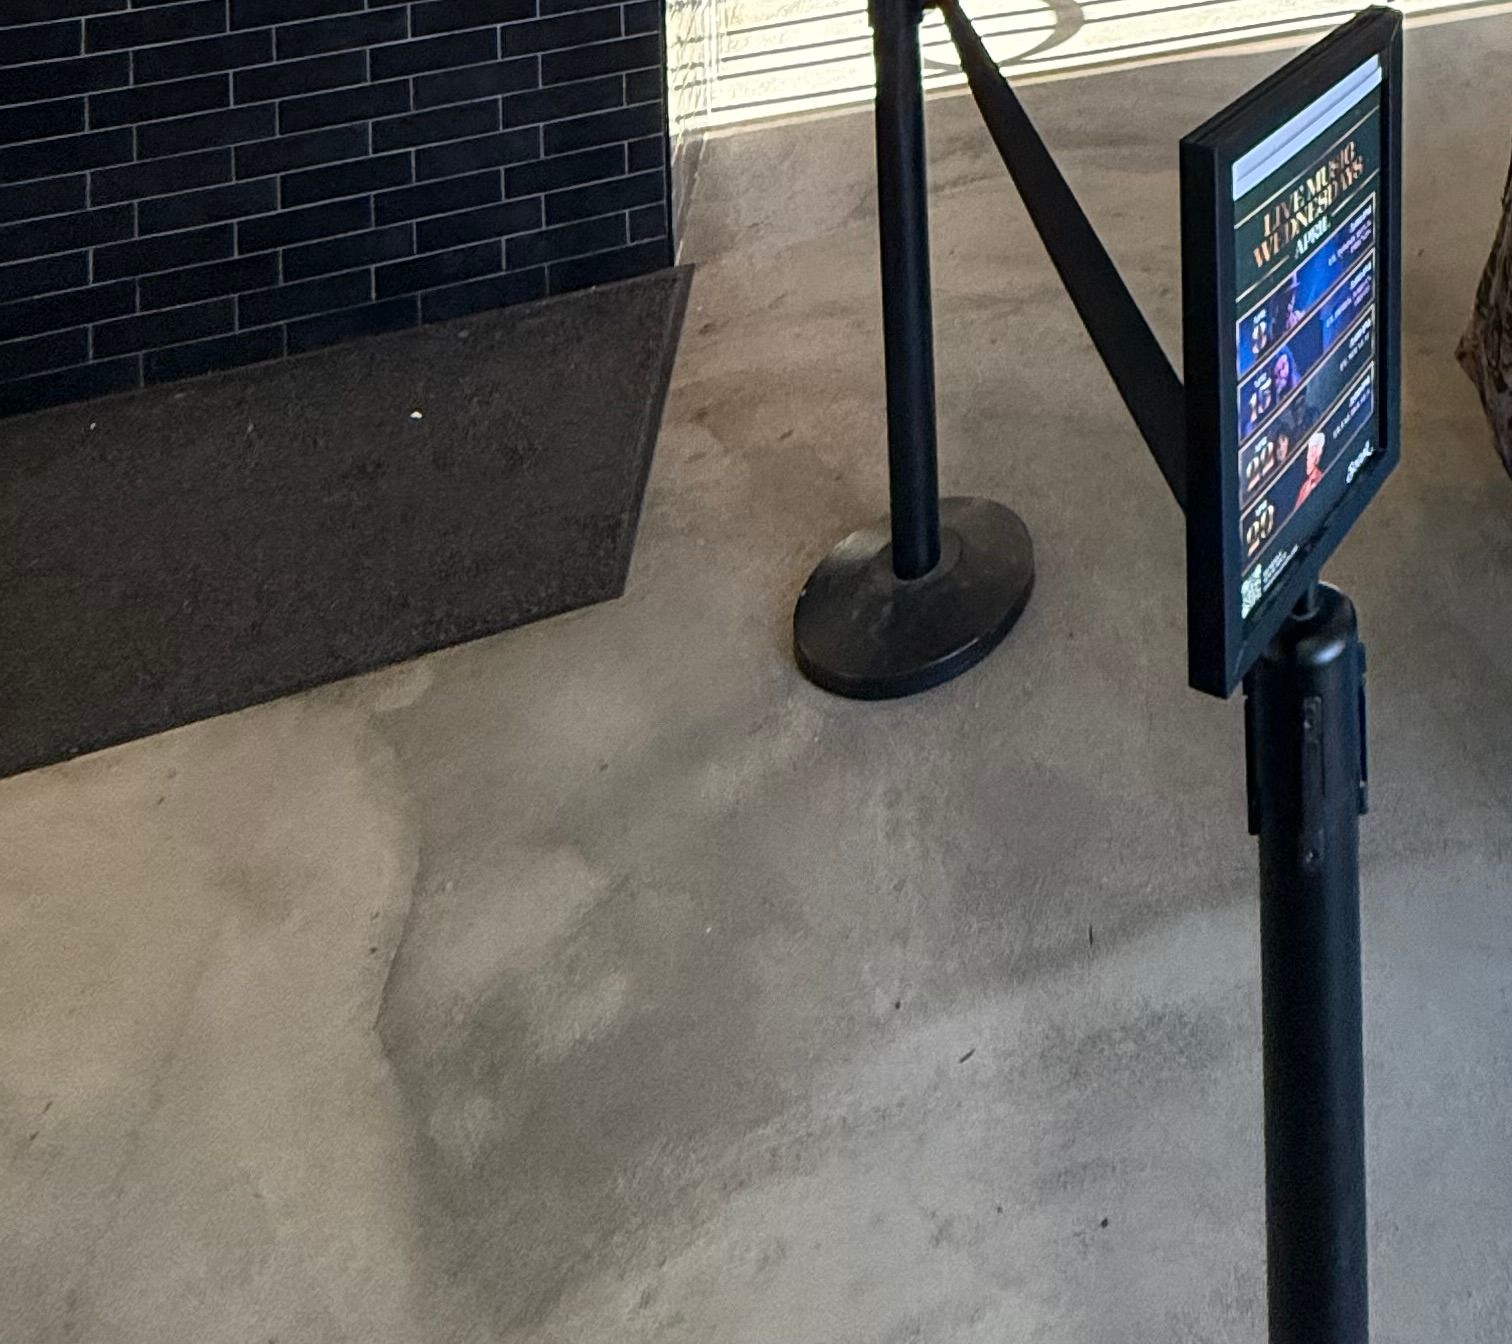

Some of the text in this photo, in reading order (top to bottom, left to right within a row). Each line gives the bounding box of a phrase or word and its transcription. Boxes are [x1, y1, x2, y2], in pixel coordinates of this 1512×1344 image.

[1253, 155, 1364, 268] WEDNESDAYS
[1263, 184, 1305, 238] LIVE
[1306, 141, 1355, 201] MUSIC
[1294, 215, 1331, 260] APRIL
[1250, 377, 1271, 422] 15
[1246, 442, 1274, 492] 22
